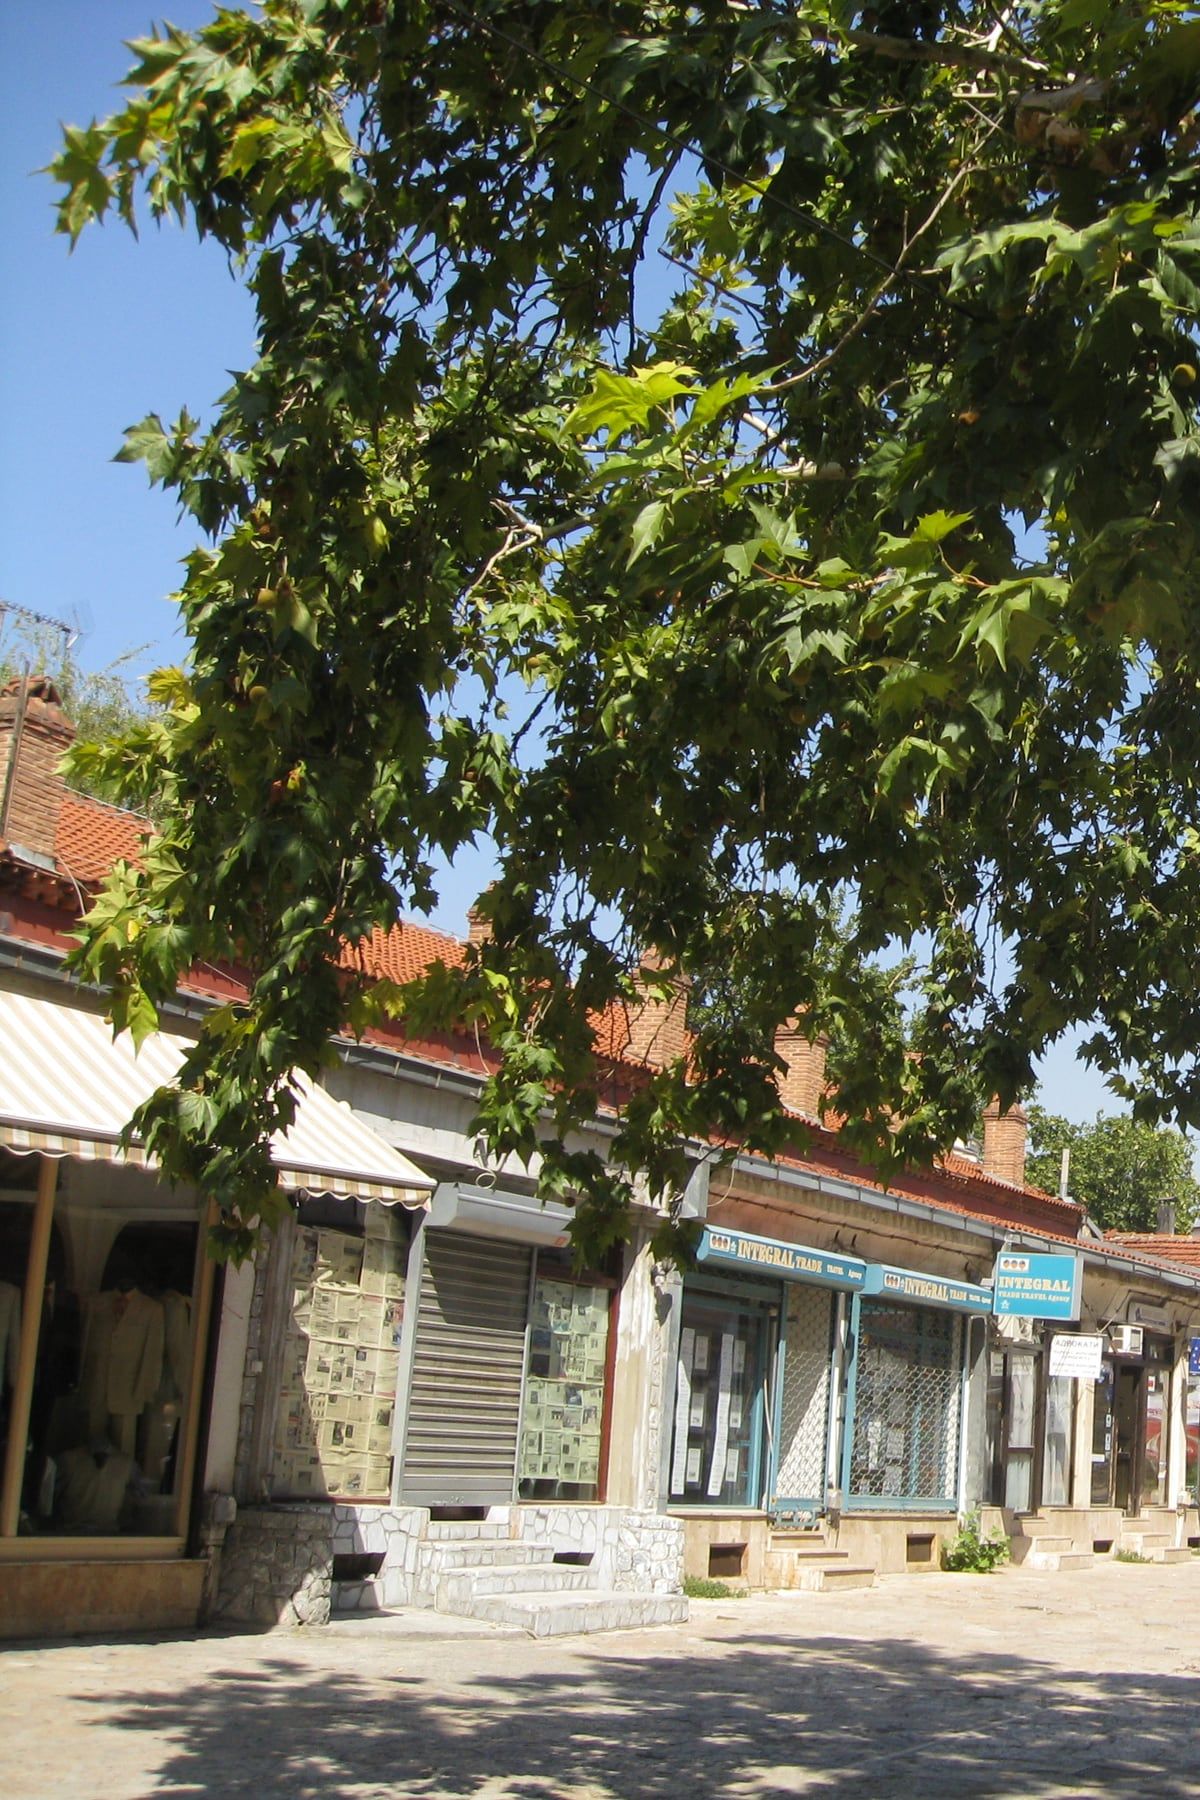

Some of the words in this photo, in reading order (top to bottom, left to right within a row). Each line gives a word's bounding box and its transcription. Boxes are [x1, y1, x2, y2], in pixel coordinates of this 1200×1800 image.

[737, 1239, 795, 1269] INTEGRAL
[796, 1256, 823, 1274] TRADE
[904, 1276, 949, 1302] INTEGRAL
[998, 1276, 1071, 1292] INTEGRAL
[1021, 1292, 1047, 1301] TRAVEL
